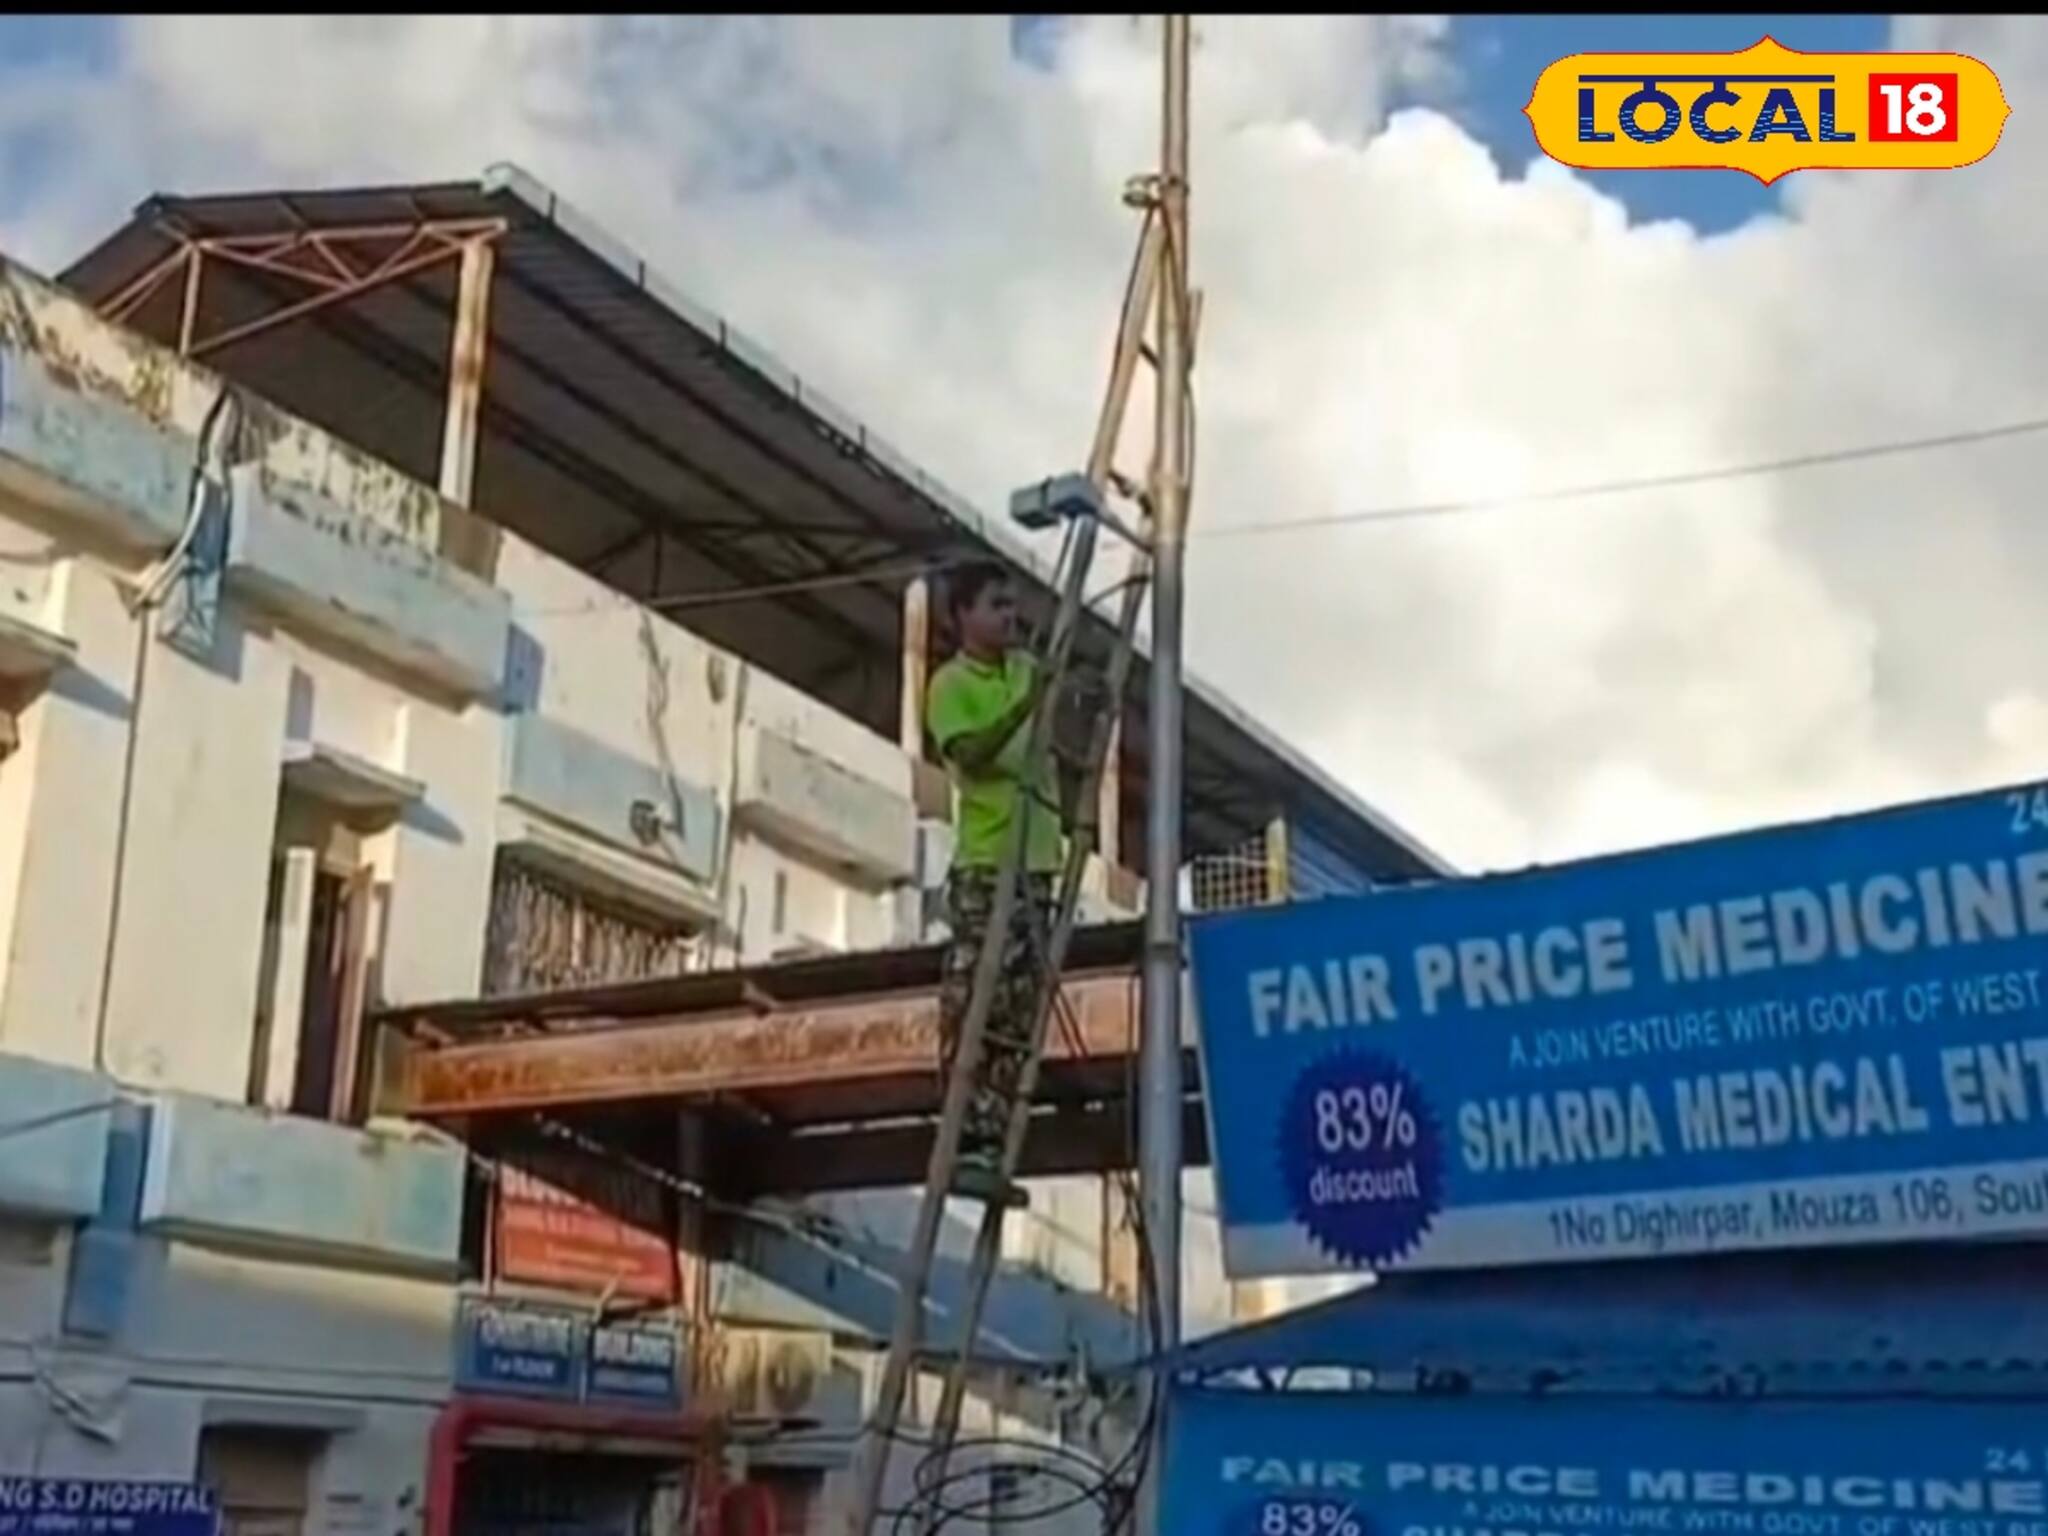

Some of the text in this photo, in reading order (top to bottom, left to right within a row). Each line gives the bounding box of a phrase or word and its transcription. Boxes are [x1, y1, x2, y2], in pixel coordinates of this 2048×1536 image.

[1248, 850, 2048, 1037] FAIR PRICE MEDICINE
[1508, 1034, 1528, 1070] A
[1533, 1027, 1591, 1068] JOIN
[1594, 1008, 1723, 1058] VENTURE
[1726, 998, 1800, 1044] WITH
[1903, 980, 1943, 1024] OF
[1953, 968, 2042, 1017] WEST
[1315, 1082, 1417, 1152] 83%
[1459, 1083, 1665, 1172] SHARDA
[1673, 1053, 1929, 1153] MEDICAL
[1309, 1160, 1420, 1205] discount
[1770, 1190, 1880, 1233] Mouza
[1984, 1447, 2030, 1473] 24
[88, 1484, 210, 1515] HOSPITAL
[1221, 1456, 2045, 1514] FAIR PRICE MEDICINE
[1261, 1502, 1362, 1536] 83%
[1549, 1503, 1673, 1528] VENTURE
[1682, 1507, 1754, 1531] WITH
